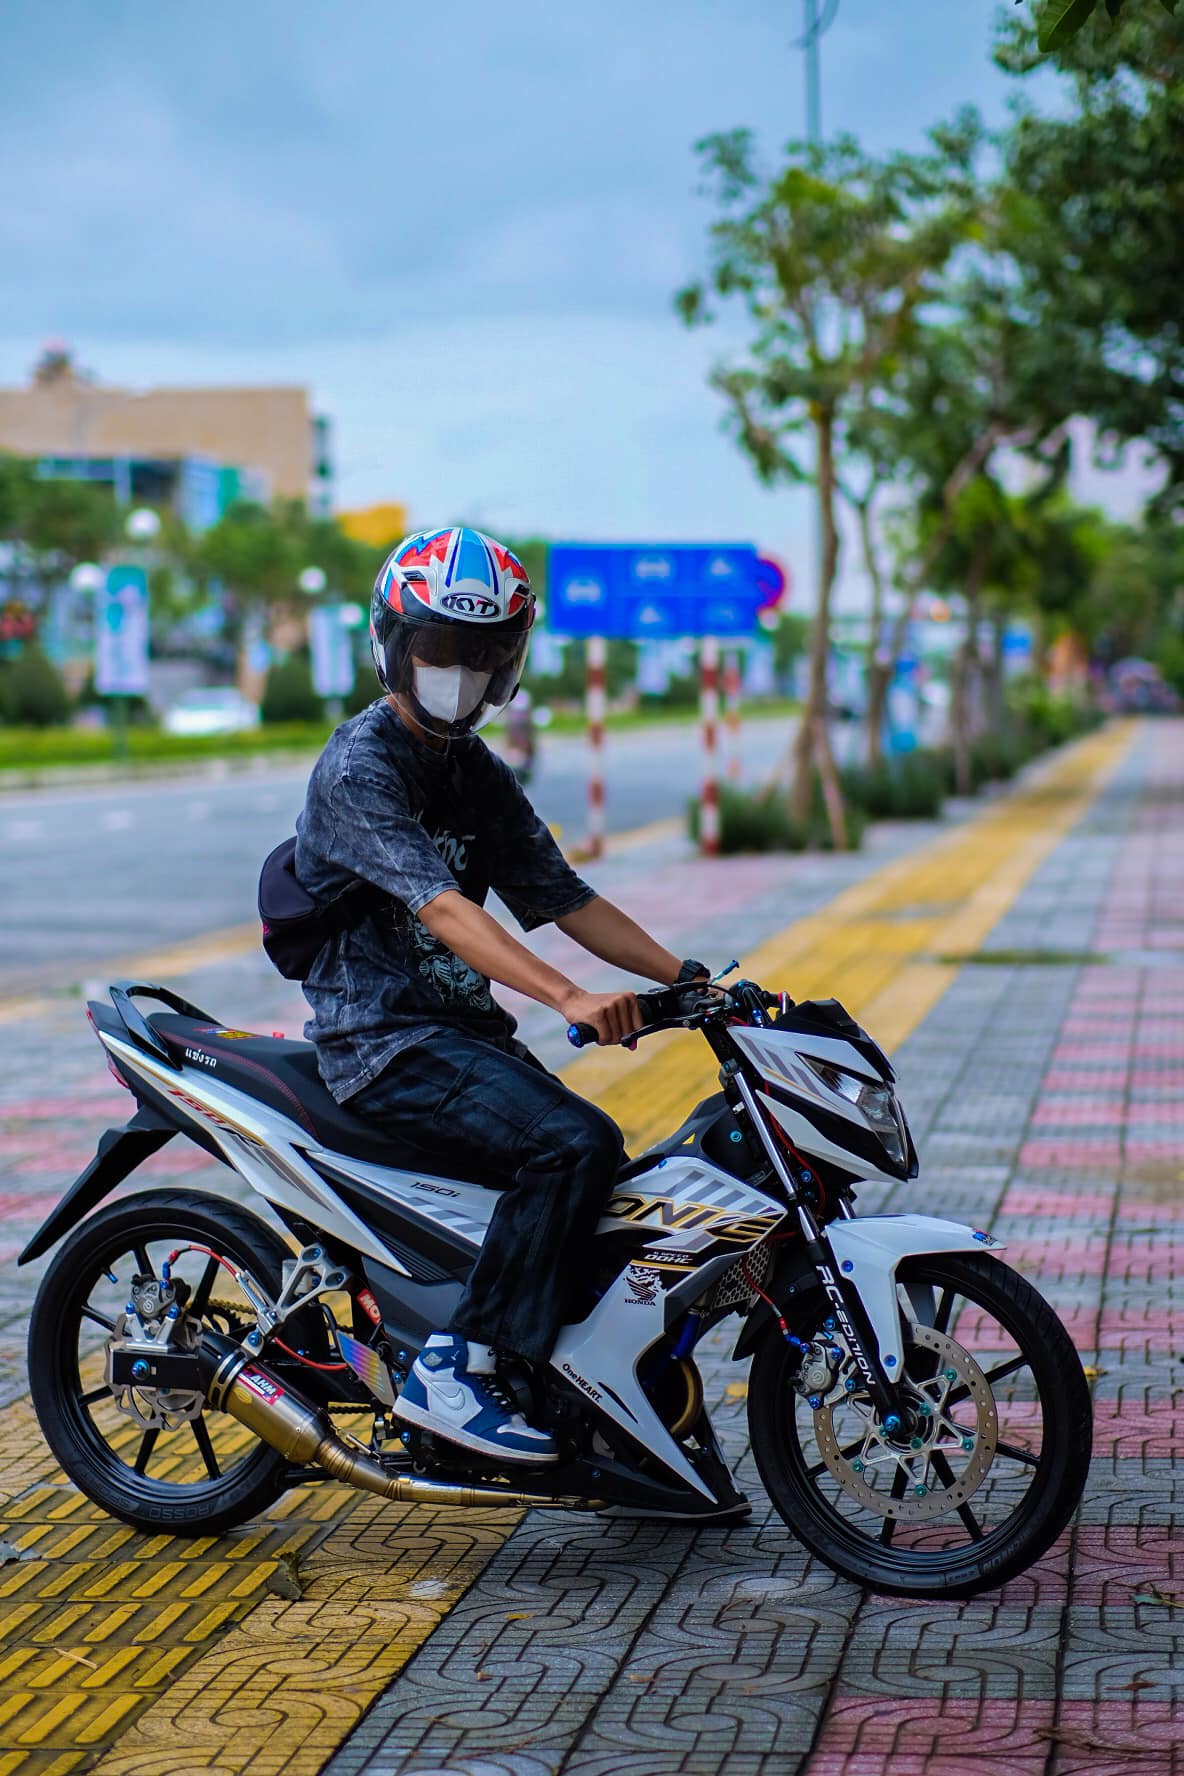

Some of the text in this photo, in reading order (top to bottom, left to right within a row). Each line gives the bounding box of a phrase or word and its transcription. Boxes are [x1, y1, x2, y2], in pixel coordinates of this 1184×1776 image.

[442, 595, 499, 616] KYT
[603, 1193, 788, 1243] ONIC
[624, 1298, 657, 1307] HONDA
